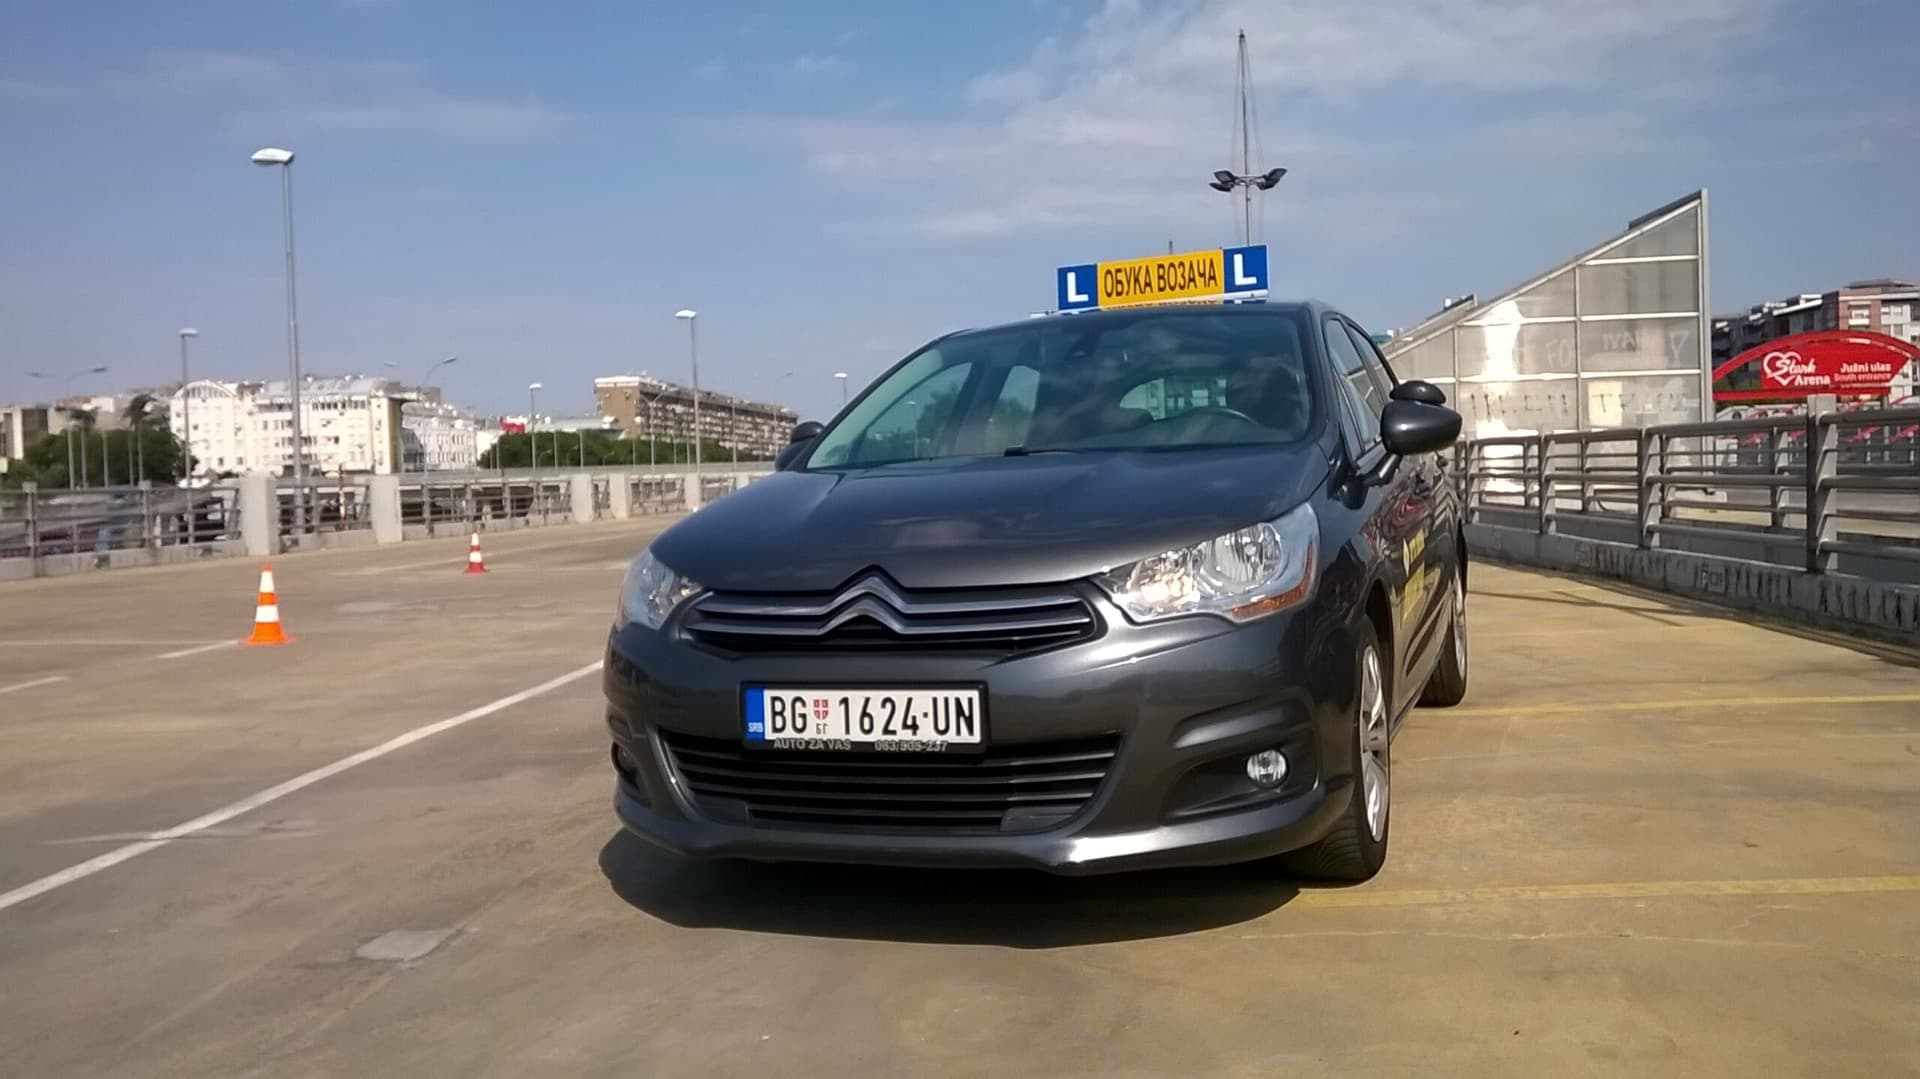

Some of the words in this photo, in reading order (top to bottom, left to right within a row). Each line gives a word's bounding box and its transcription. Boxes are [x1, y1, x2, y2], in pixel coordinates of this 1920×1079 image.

[1103, 263, 1154, 298] ОБУКА
[1157, 257, 1218, 292] ВОЗАЧА
[1233, 253, 1258, 286] L
[1066, 271, 1089, 303] L
[1794, 375, 1831, 386] Arena
[748, 722, 764, 733] SRB
[769, 695, 808, 734] BG
[773, 738, 806, 750] AUTO
[808, 738, 825, 750] ZA
[828, 739, 852, 751] VAS
